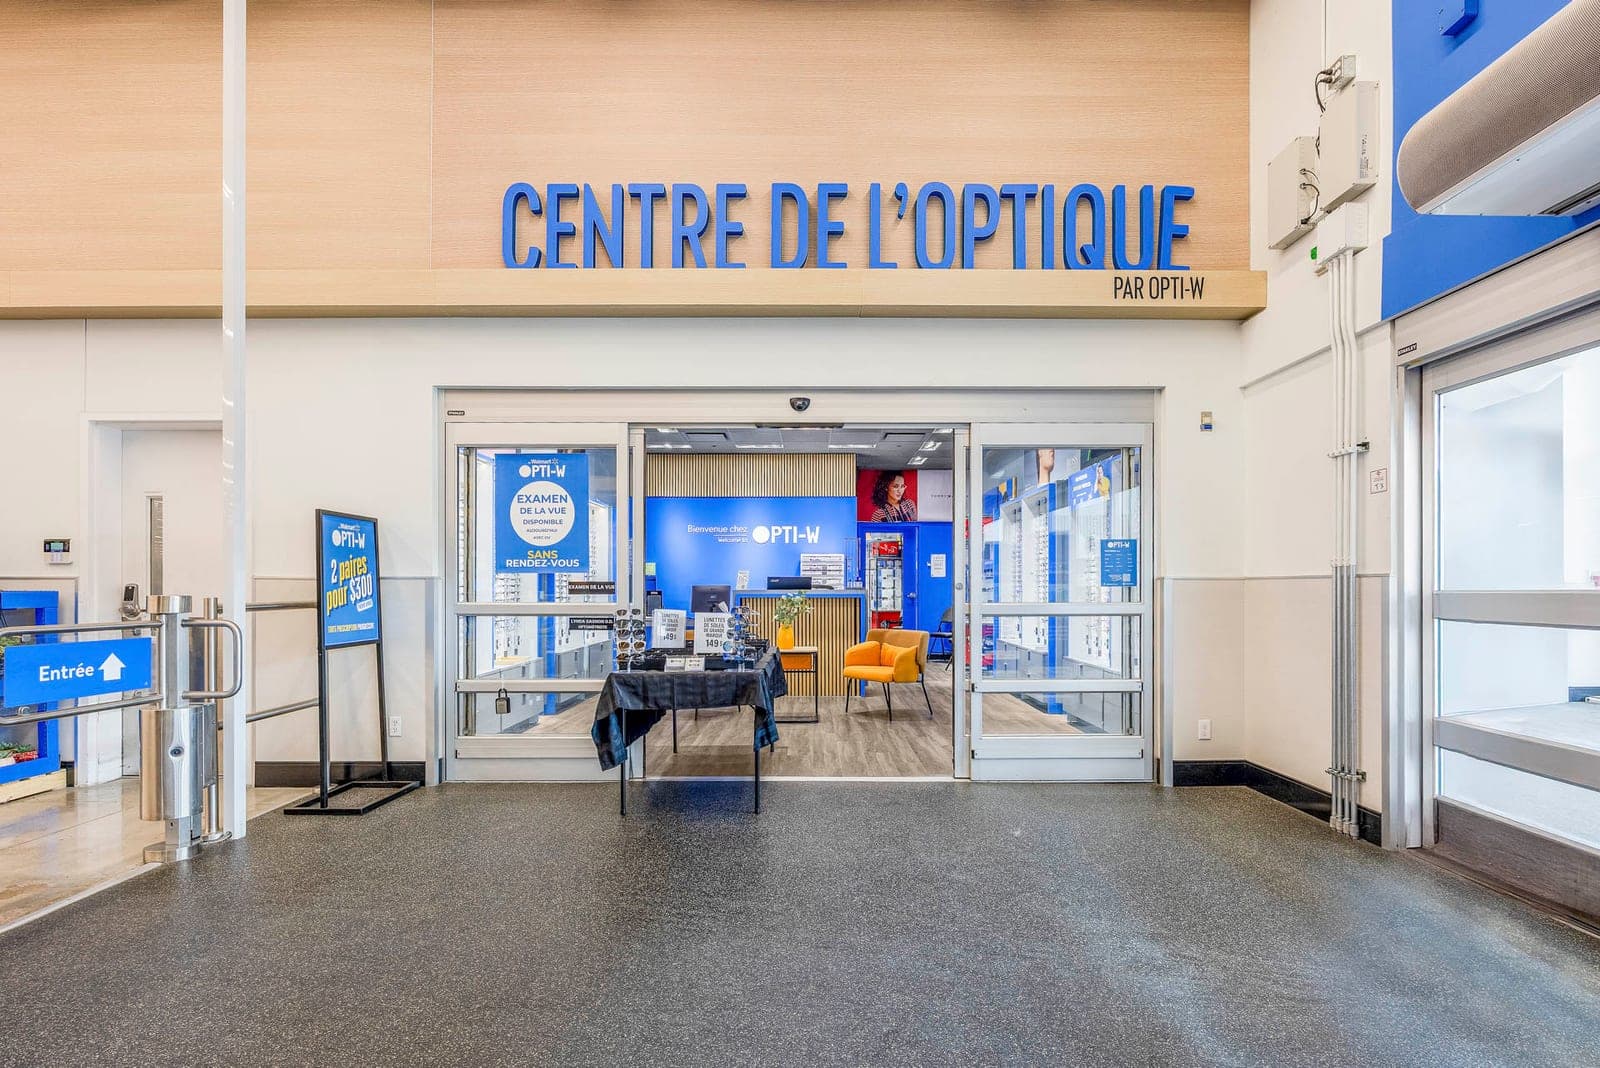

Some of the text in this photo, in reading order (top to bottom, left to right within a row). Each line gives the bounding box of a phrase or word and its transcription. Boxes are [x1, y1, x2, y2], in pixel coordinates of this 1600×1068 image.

[502, 181, 1195, 271] CENTRE DE L'OPTIQUE
[1113, 276, 1205, 300] PAR OPTI-W
[518, 464, 566, 478] OPTI-W
[517, 494, 568, 504] EXAMEN
[520, 507, 567, 515] DE LA VUE
[687, 524, 748, 533] Bienvenue chez
[752, 525, 821, 544] OPTI-W
[332, 530, 365, 549] OPTI-W
[527, 550, 558, 559] SANS
[330, 554, 367, 586] 2 paires
[506, 559, 580, 568] RENDEZ-VOUS
[326, 585, 348, 616] pour
[349, 573, 373, 605] $300
[705, 639, 719, 648] 149
[39, 662, 95, 682] Entrée
